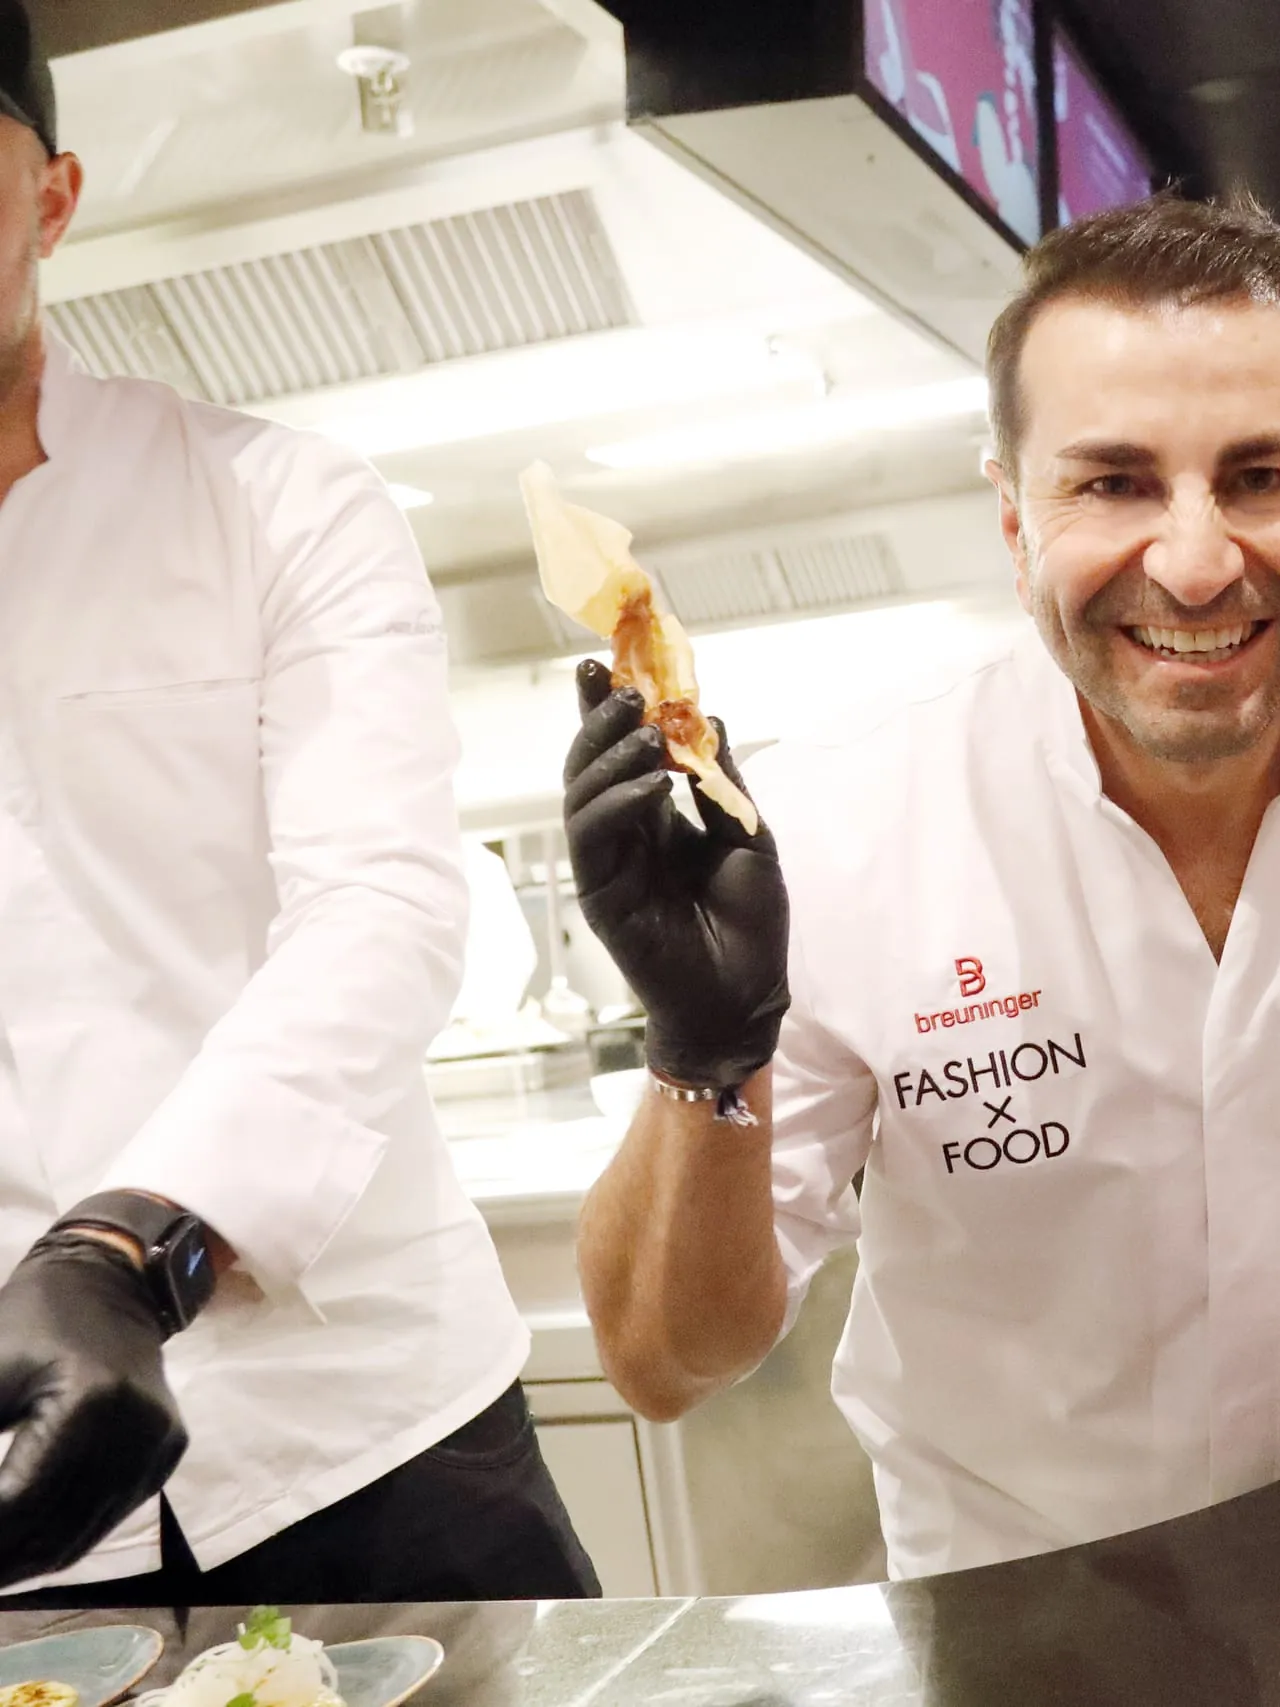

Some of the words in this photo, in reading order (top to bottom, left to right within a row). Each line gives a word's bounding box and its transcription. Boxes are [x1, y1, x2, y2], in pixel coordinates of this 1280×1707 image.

[914, 989, 1042, 1034] breuninger
[893, 1033, 1087, 1109] FASHION
[942, 1121, 1070, 1174] FOOD
